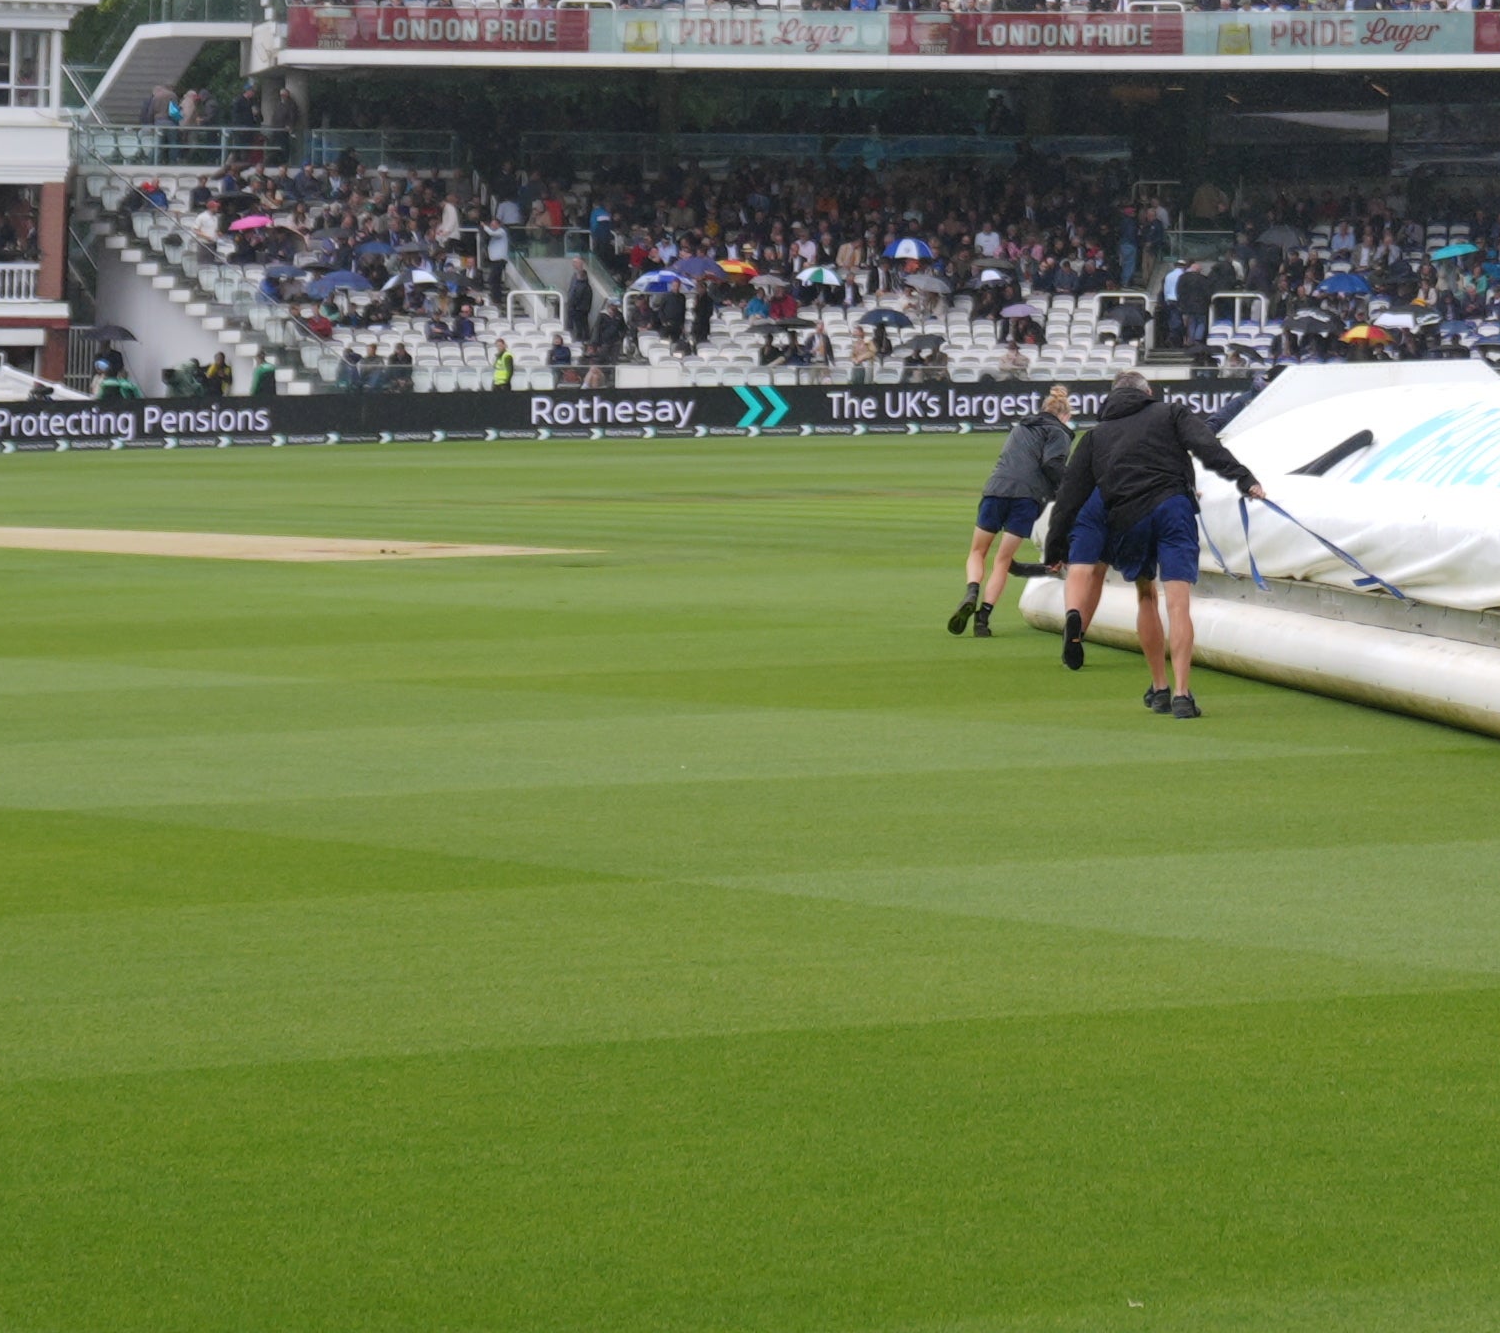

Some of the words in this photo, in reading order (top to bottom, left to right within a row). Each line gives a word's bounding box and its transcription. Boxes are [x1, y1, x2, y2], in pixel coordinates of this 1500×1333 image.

[377, 18, 479, 42] LONDON
[484, 17, 558, 42] PRIDE
[678, 18, 764, 46] PRIDE
[770, 17, 854, 52] Lager
[976, 23, 1079, 47] LONDON
[1082, 22, 1154, 47] PRIDE
[1269, 19, 1355, 47] PRIDE
[1360, 17, 1440, 52] Lager
[143, 404, 270, 433] Pensions
[531, 395, 695, 428] Rothesay
[827, 391, 874, 420] The
[884, 390, 941, 419] UK's
[948, 389, 1038, 424] largest
